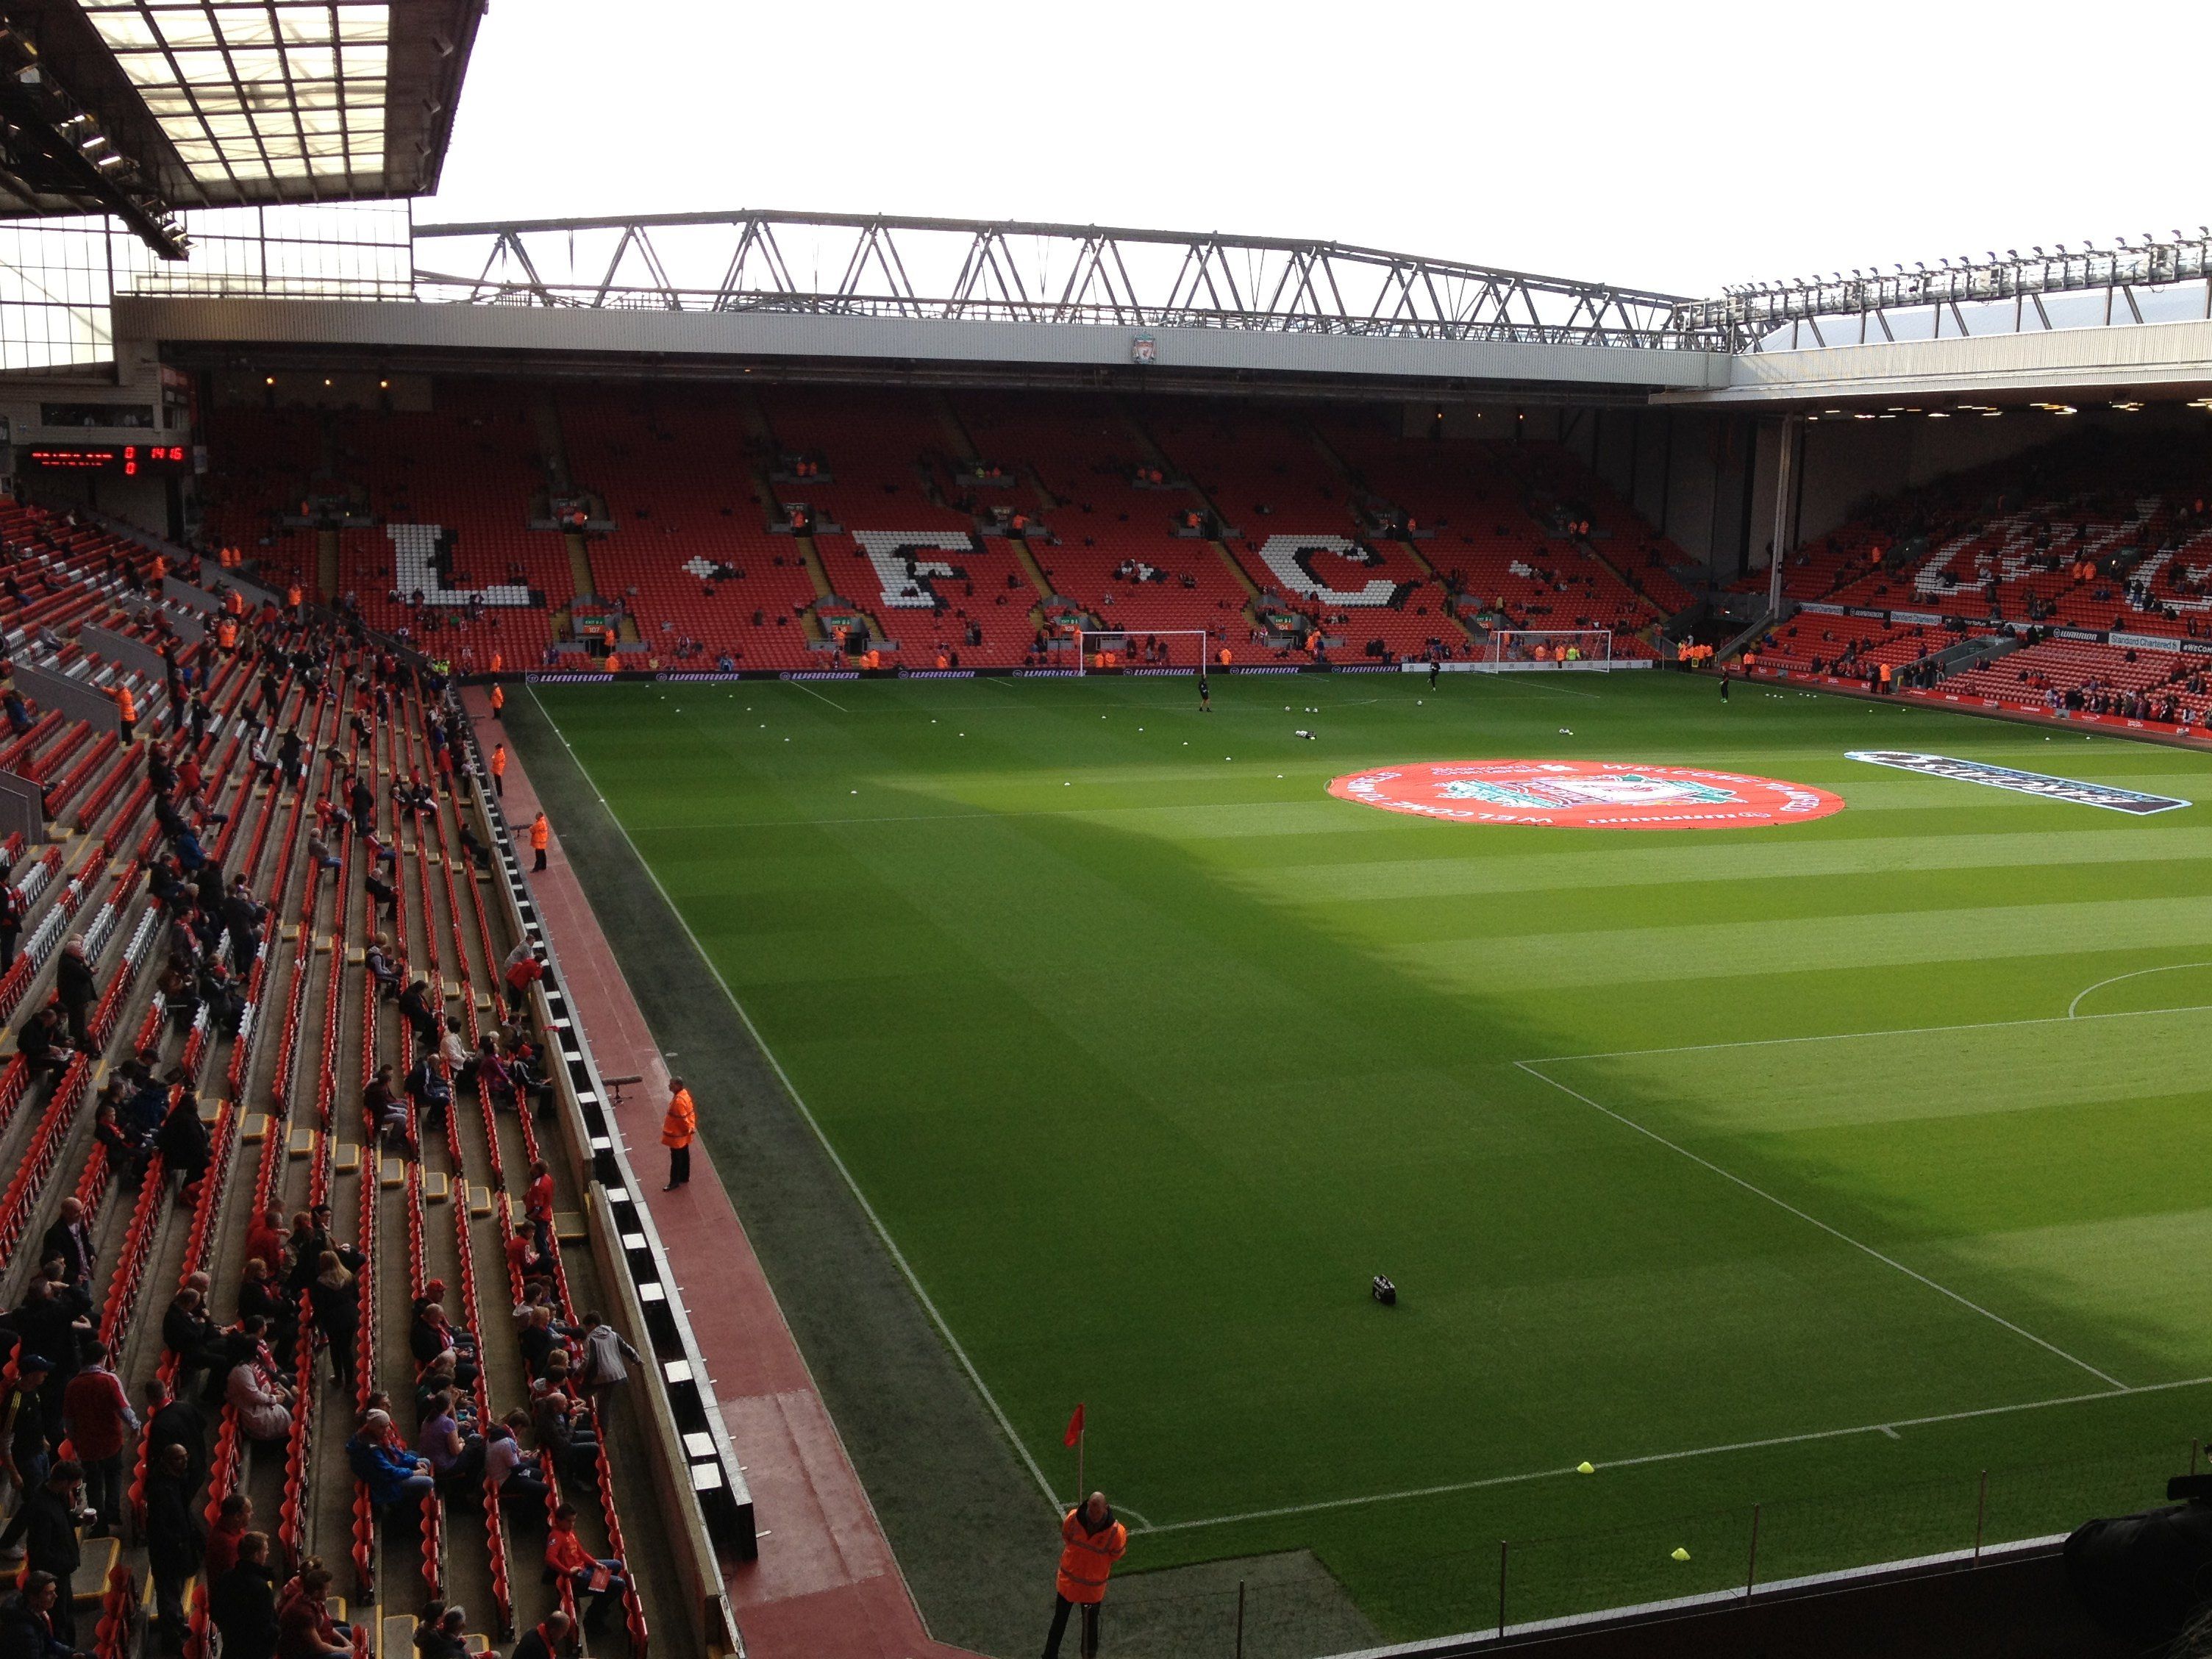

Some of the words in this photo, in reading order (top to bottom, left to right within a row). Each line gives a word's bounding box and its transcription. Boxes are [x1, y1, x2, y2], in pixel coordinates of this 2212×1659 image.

[1891, 613, 1911, 621] Standard
[1912, 616, 1936, 624] Chartered
[2061, 631, 2097, 641] WARRIOR
[2111, 635, 2138, 645] Standard
[2140, 638, 2170, 650] Chartered
[669, 673, 740, 681] WARRIOR
[1346, 772, 1402, 793] ANFIELD
[1602, 764, 1761, 783] WELCOME
[1755, 782, 1795, 791] TO
[1778, 790, 1821, 812] ANFIELD
[1355, 793, 1393, 802] TO
[1381, 801, 1554, 823] WELCOME
[1586, 813, 1737, 824] WARRIOR
